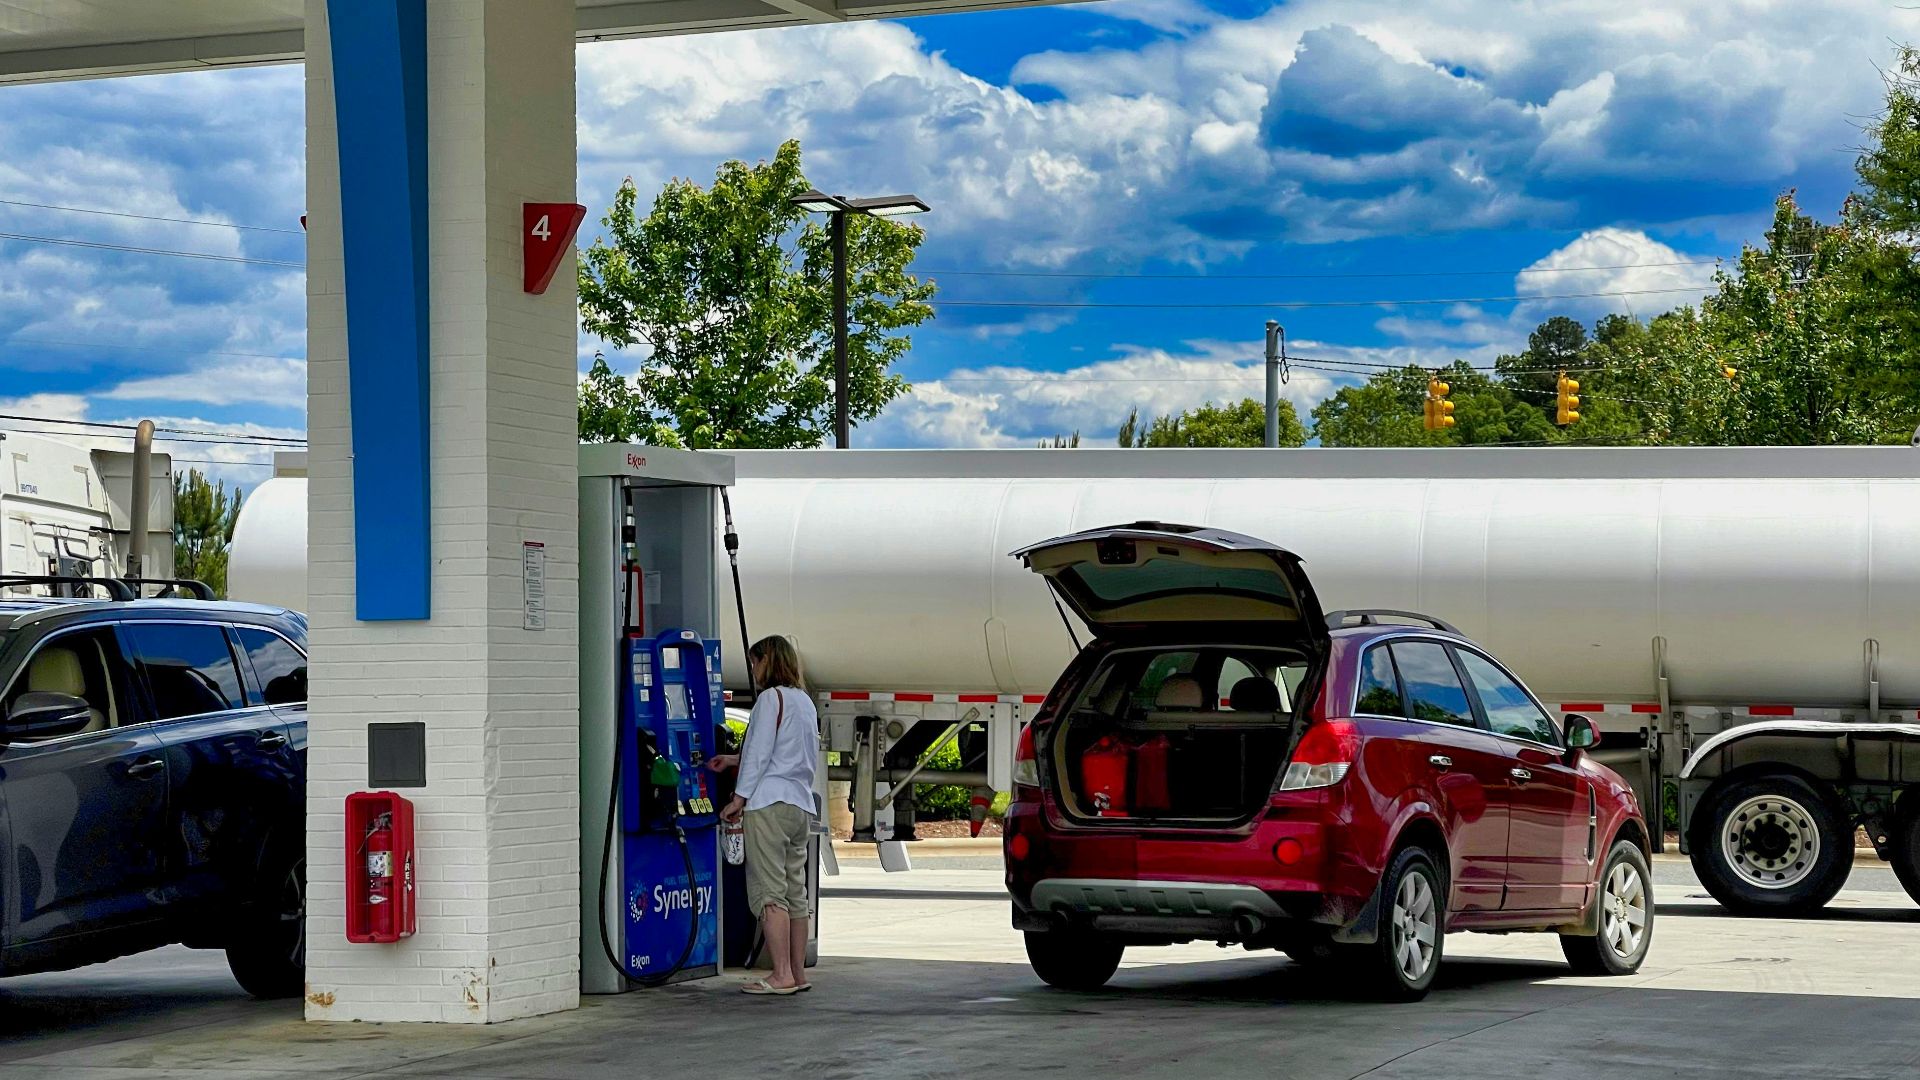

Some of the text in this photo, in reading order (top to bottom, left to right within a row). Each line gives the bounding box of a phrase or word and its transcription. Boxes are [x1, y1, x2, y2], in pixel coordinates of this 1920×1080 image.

[531, 214, 552, 242] 4
[627, 453, 646, 470] Exxon
[713, 646, 720, 660] 4
[678, 872, 712, 885] TECOLOGY
[631, 954, 650, 970] Exxon
